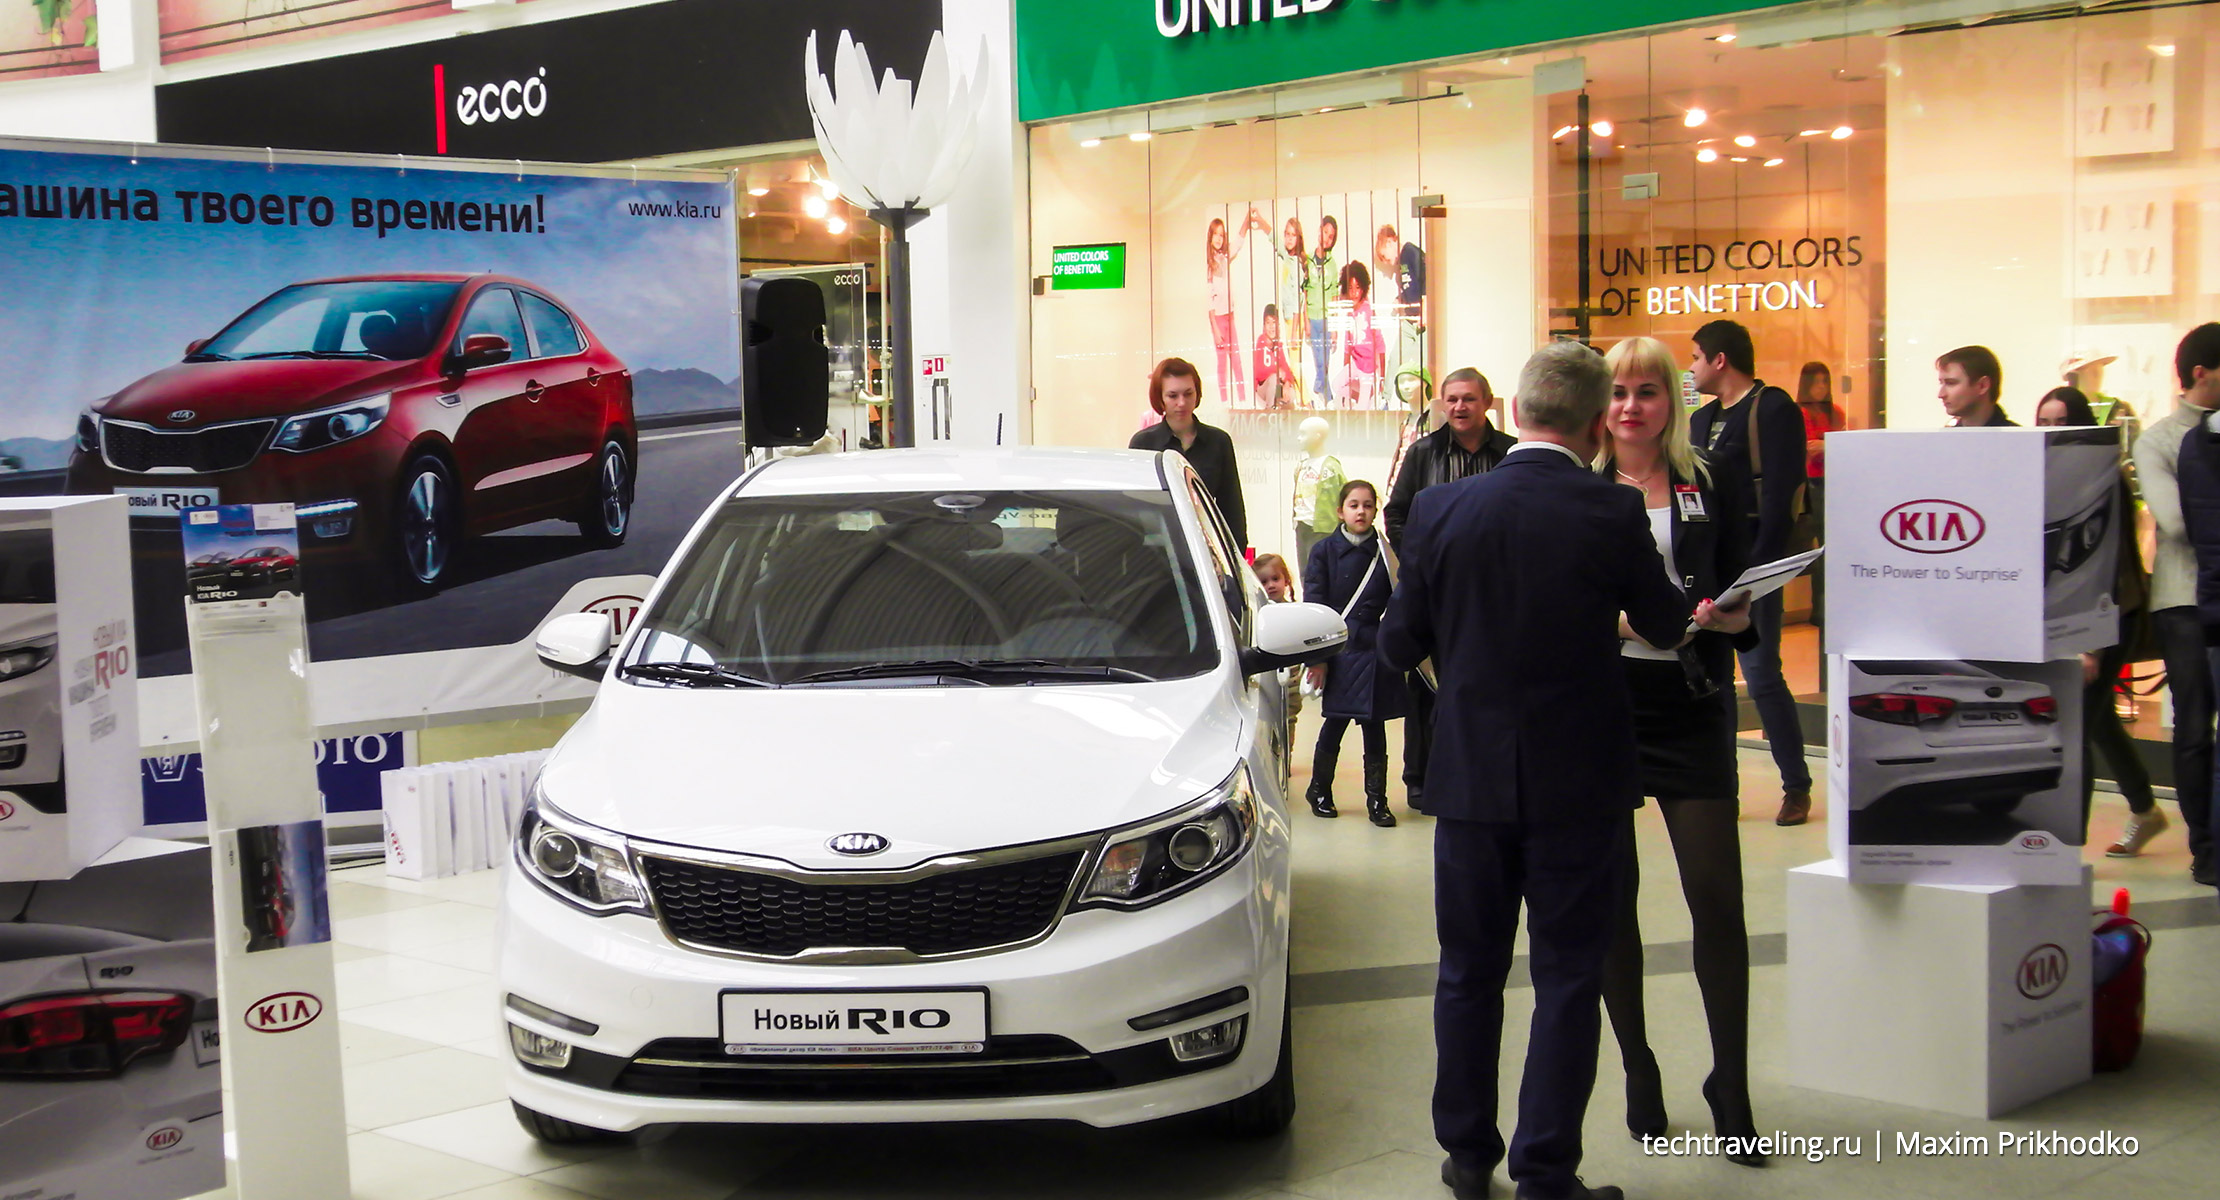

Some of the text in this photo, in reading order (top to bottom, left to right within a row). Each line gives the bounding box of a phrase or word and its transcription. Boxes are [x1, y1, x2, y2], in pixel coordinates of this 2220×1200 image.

[457, 66, 547, 125] ecco
[175, 189, 334, 227] твоего
[351, 194, 546, 238] времени!
[628, 200, 722, 219] www.kia.ru
[1054, 250, 1109, 262] UNITED COLORS
[1600, 236, 1863, 277] UNTED COLORS
[833, 274, 861, 286] ecco
[1053, 265, 1064, 275] OF
[1600, 288, 1641, 316] OF
[128, 494, 211, 511] овый RIO
[1898, 512, 1968, 542] KIA
[1851, 564, 1878, 578] The
[1883, 565, 1930, 579] Power
[1935, 567, 1951, 580] to
[210, 591, 238, 599] RIO
[94, 645, 129, 690] RIO
[836, 834, 881, 850] KIA
[2023, 953, 2061, 991] KIA
[258, 999, 311, 1027] KIA
[753, 1008, 951, 1035] Новый RIO
[151, 1130, 177, 1148] KIA
